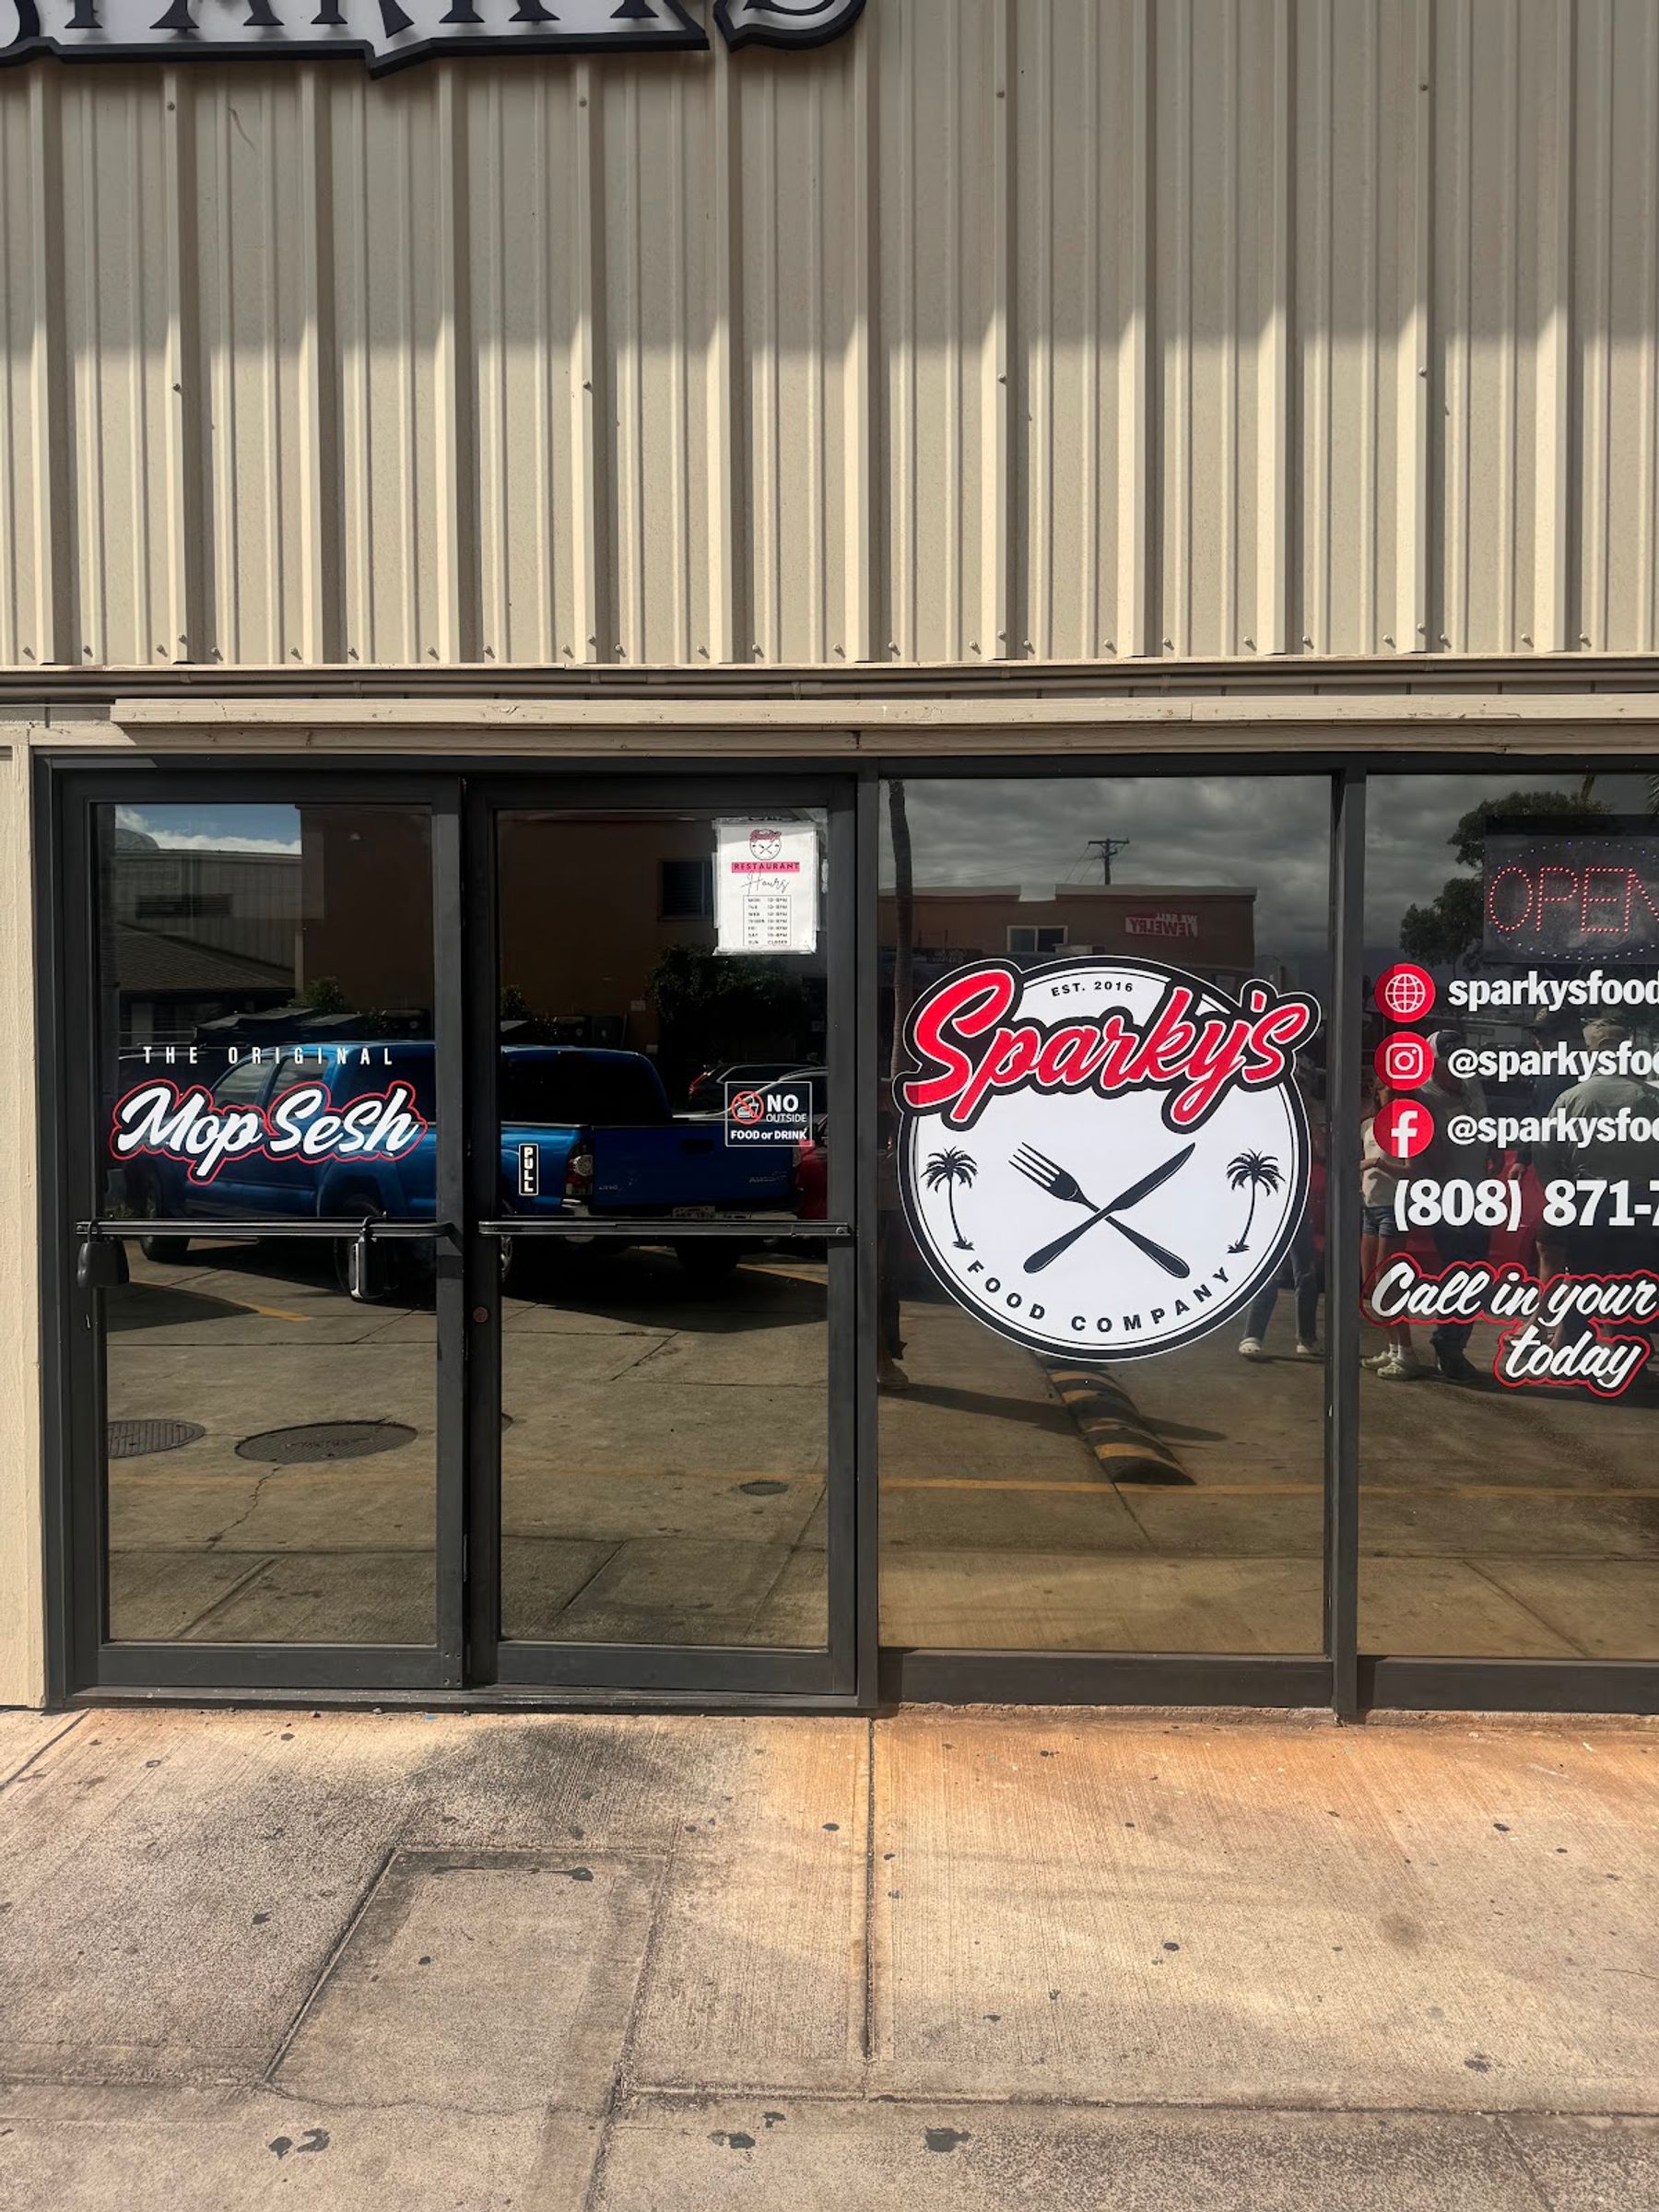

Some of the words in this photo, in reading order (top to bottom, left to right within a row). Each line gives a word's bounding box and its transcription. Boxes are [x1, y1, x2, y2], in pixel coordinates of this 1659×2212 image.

[1488, 865, 1659, 933] OPEN
[1051, 982, 1086, 997] EST.
[1095, 981, 1134, 993] 2016
[143, 1046, 197, 1065] THE
[229, 1046, 393, 1065] ORIGINAL
[904, 969, 1310, 1125] Sparky's
[766, 1113, 807, 1123] OUTSIDE
[767, 1094, 799, 1112] NO
[117, 1086, 262, 1177] Mop
[731, 1130, 759, 1140] FOOD
[760, 1131, 773, 1139] or
[774, 1129, 807, 1140] DRINK
[524, 1147, 534, 1193] PULL
[1394, 1179, 1522, 1231] (808)
[967, 1259, 1046, 1320] FOOD
[1071, 1267, 1230, 1333] COMPANY
[1371, 1262, 1489, 1317] Call
[1490, 1272, 1539, 1316] in
[1538, 1279, 1658, 1326] your
[1505, 1324, 1641, 1388] today
